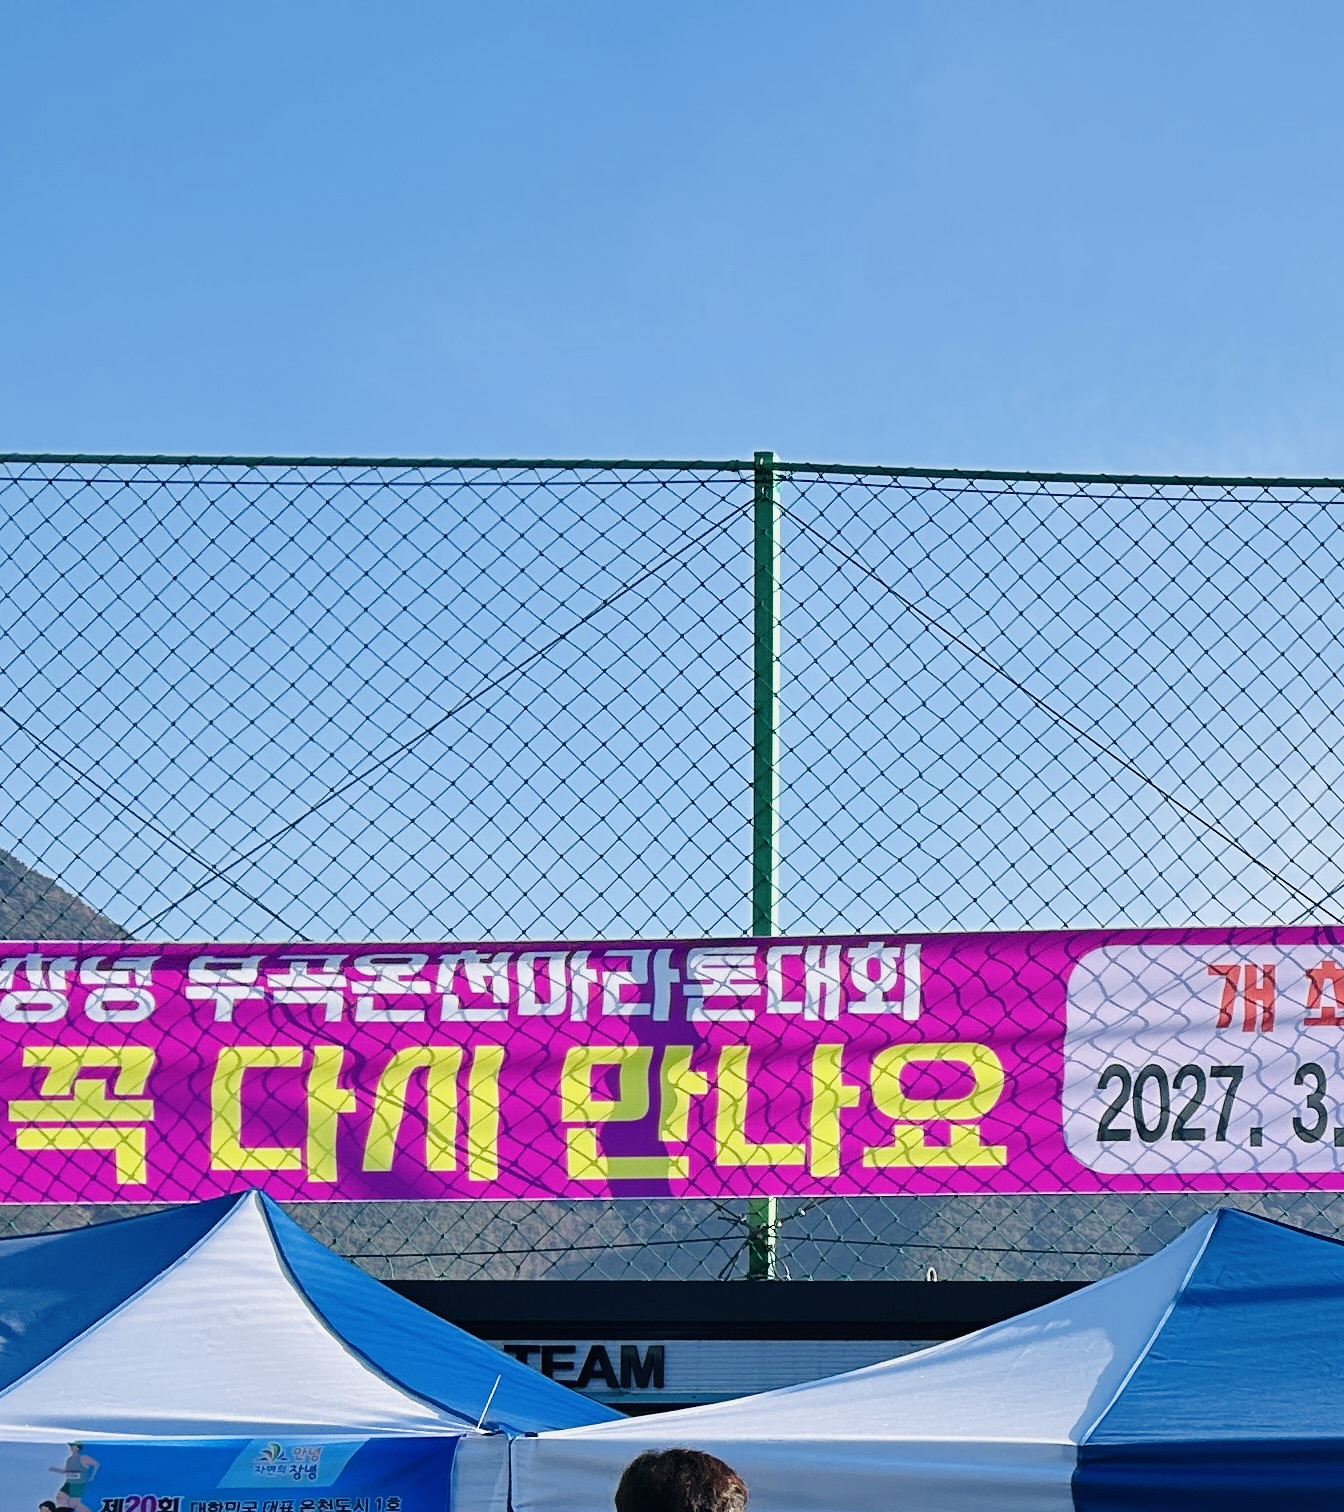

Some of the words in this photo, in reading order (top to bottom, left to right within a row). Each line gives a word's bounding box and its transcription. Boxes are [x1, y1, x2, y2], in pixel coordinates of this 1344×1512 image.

[186, 942, 922, 1023] 부곡온천마라톤대회
[8, 1046, 155, 1185] 꼭
[211, 1045, 504, 1183] 다시
[561, 1042, 1007, 1180] 만나요
[1096, 1062, 1263, 1148] 2027.
[503, 1345, 664, 1388] TEAM
[375, 1496, 402, 1512] 1호
